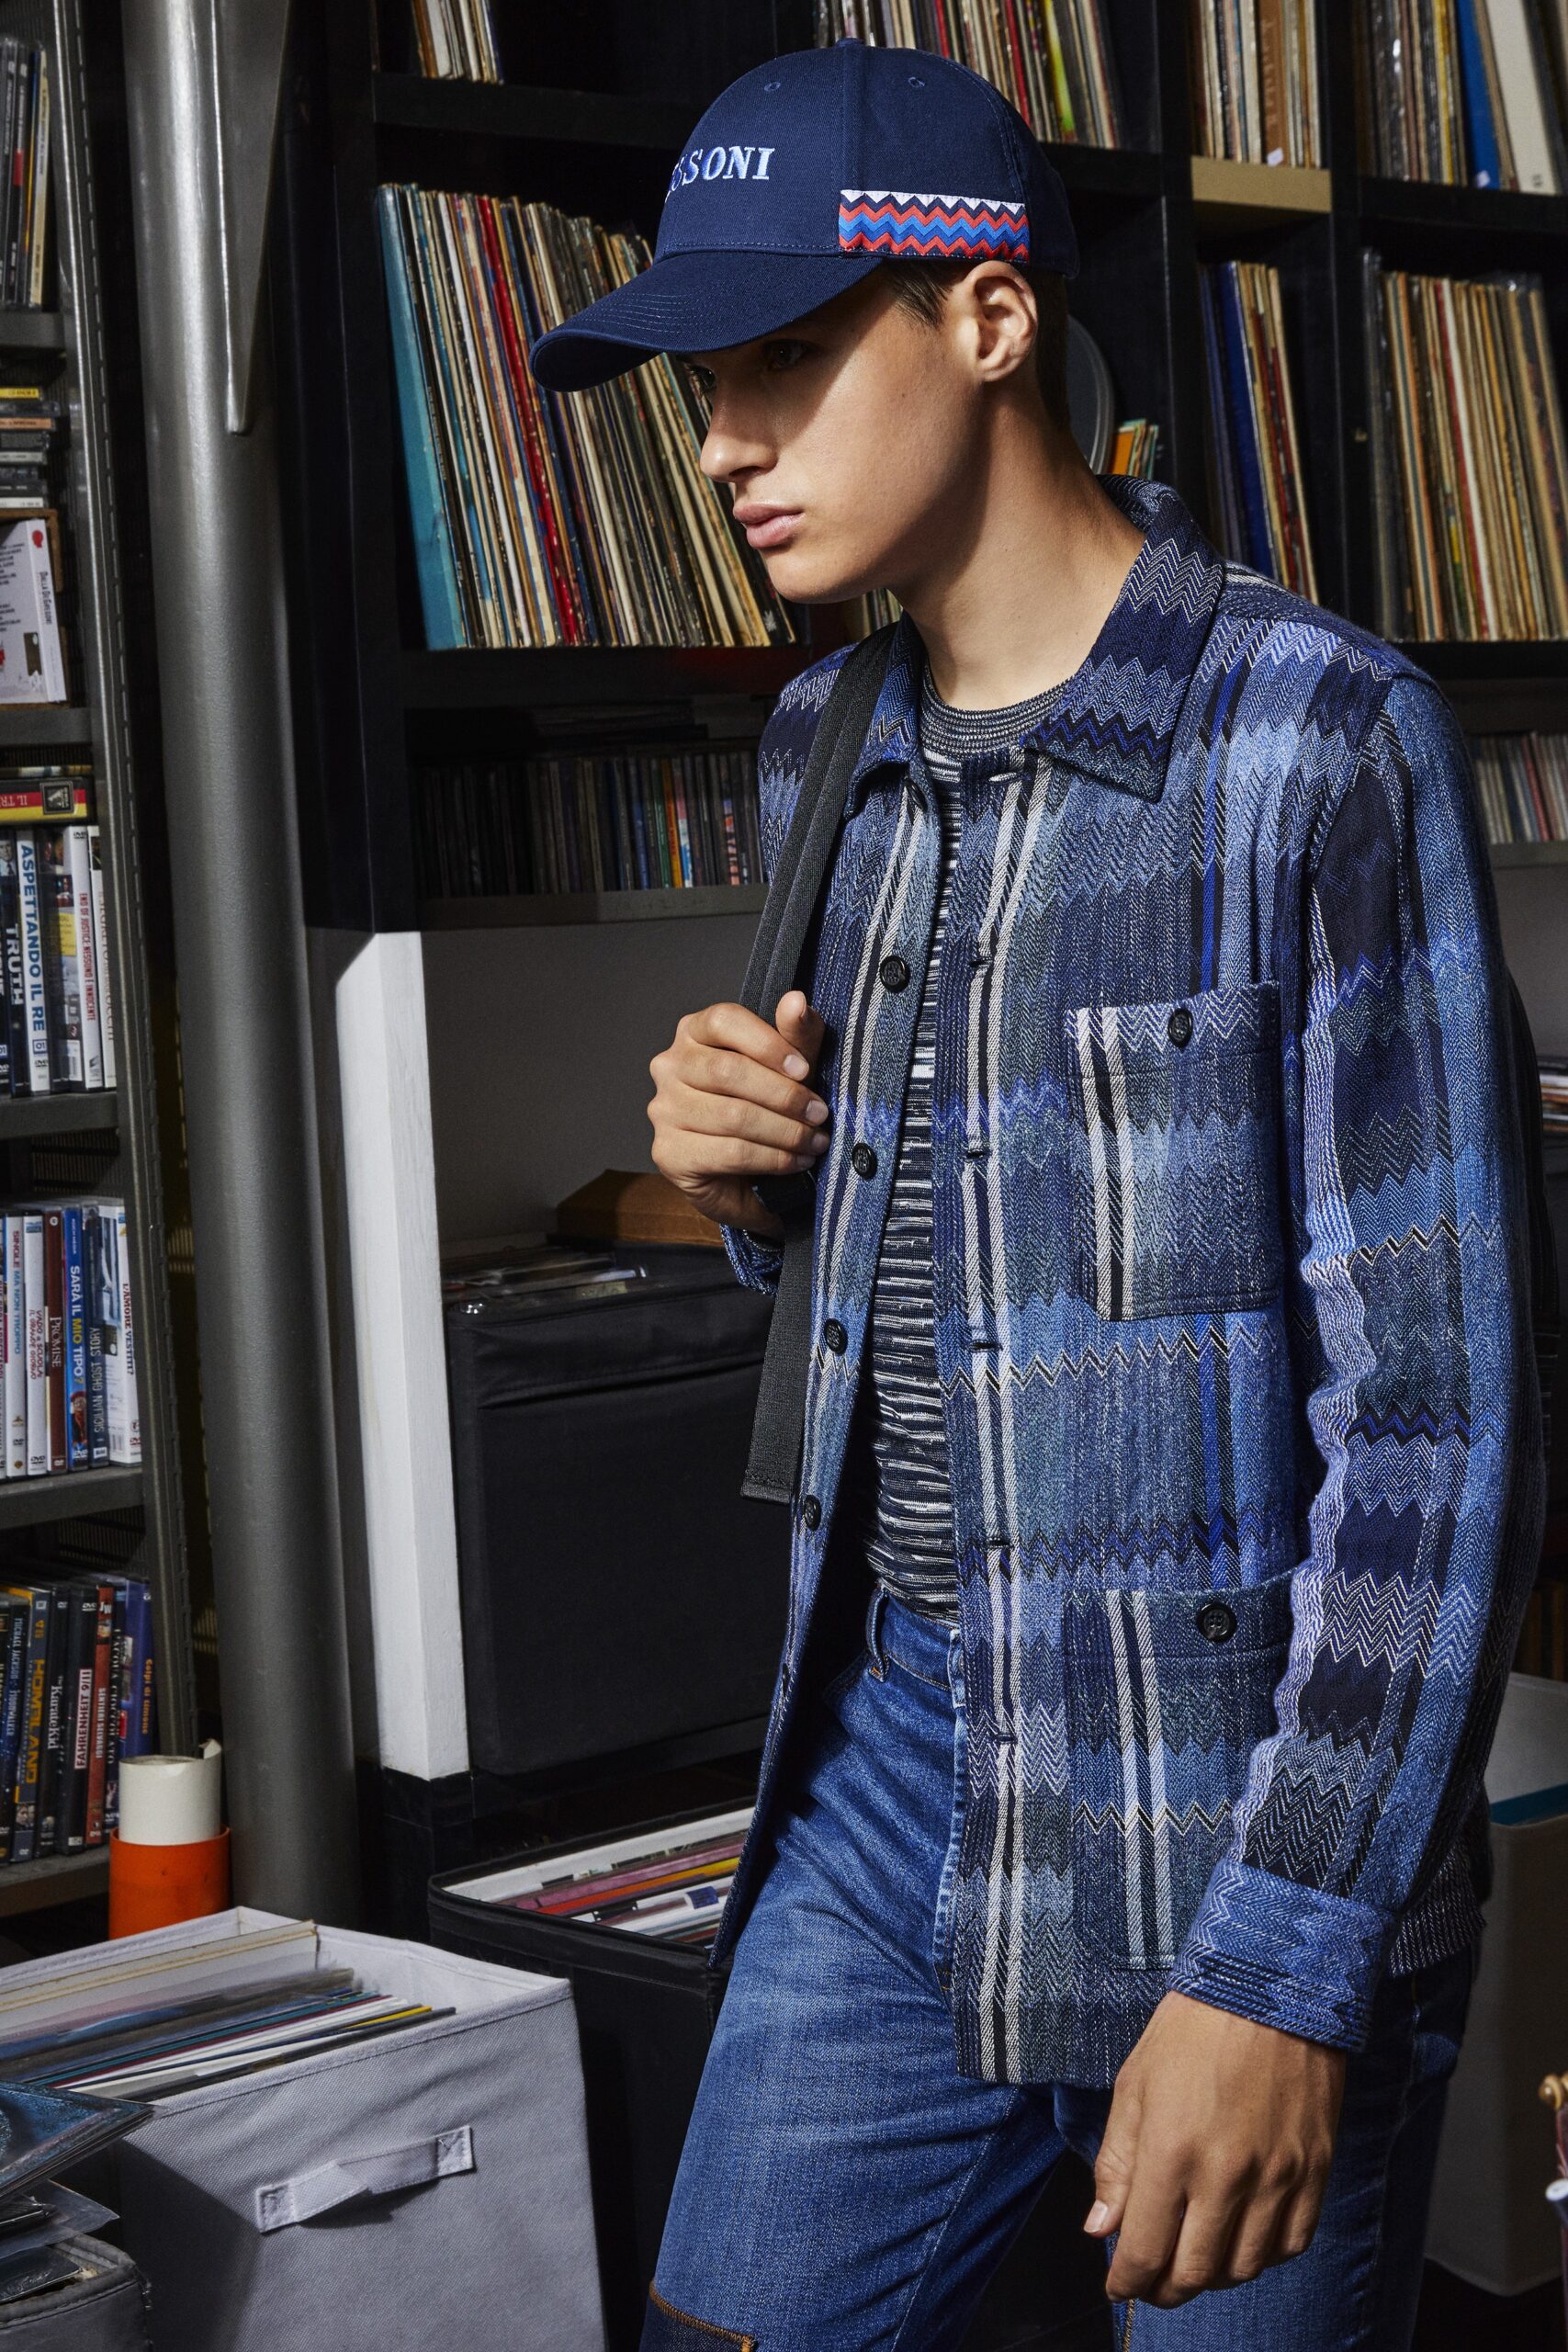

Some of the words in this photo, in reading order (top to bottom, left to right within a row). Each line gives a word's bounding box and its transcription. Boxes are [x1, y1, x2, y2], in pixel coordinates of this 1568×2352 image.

[664, 145, 775, 203] SSONI
[0, 796, 16, 808] TR
[17, 795, 28, 806] IL
[21, 844, 42, 978] ASPETTANDO
[80, 892, 89, 906] END
[80, 907, 90, 916] OF
[6, 922, 24, 1005] TRUTH
[30, 983, 43, 1001] IL
[85, 984, 96, 1022] INNOCENTE
[32, 1006, 45, 1031] RE
[13, 1230, 21, 1269] SINGLE
[14, 1271, 20, 1286] MA
[71, 1265, 84, 1303] SARÀ
[72, 1305, 82, 1316] IL
[122, 1283, 133, 1329] L'AMORE
[36, 1309, 44, 1334] VADO
[72, 1318, 83, 1344] MIO
[50, 1317, 62, 1368] PROMISE
[89, 1327, 101, 1357] STORY
[73, 1345, 85, 1385] TIPO?
[91, 1362, 103, 1391] GHOST
[92, 1395, 105, 1433] SICILIAN
[30, 1455, 45, 1464] DVD
[82, 1602, 96, 1611] DVD
[12, 1617, 23, 1648] MICHAEL
[9, 1649, 21, 1680] JACKSON
[143, 1658, 153, 1684] Colpi
[81, 1670, 91, 1691] 9/11
[143, 1686, 152, 1697] di
[96, 1687, 107, 1722] SENTIERI
[142, 1699, 151, 1735] timone
[76, 1695, 89, 1767] FAHRENHEIT
[95, 1723, 105, 1758] SELVAGGI
